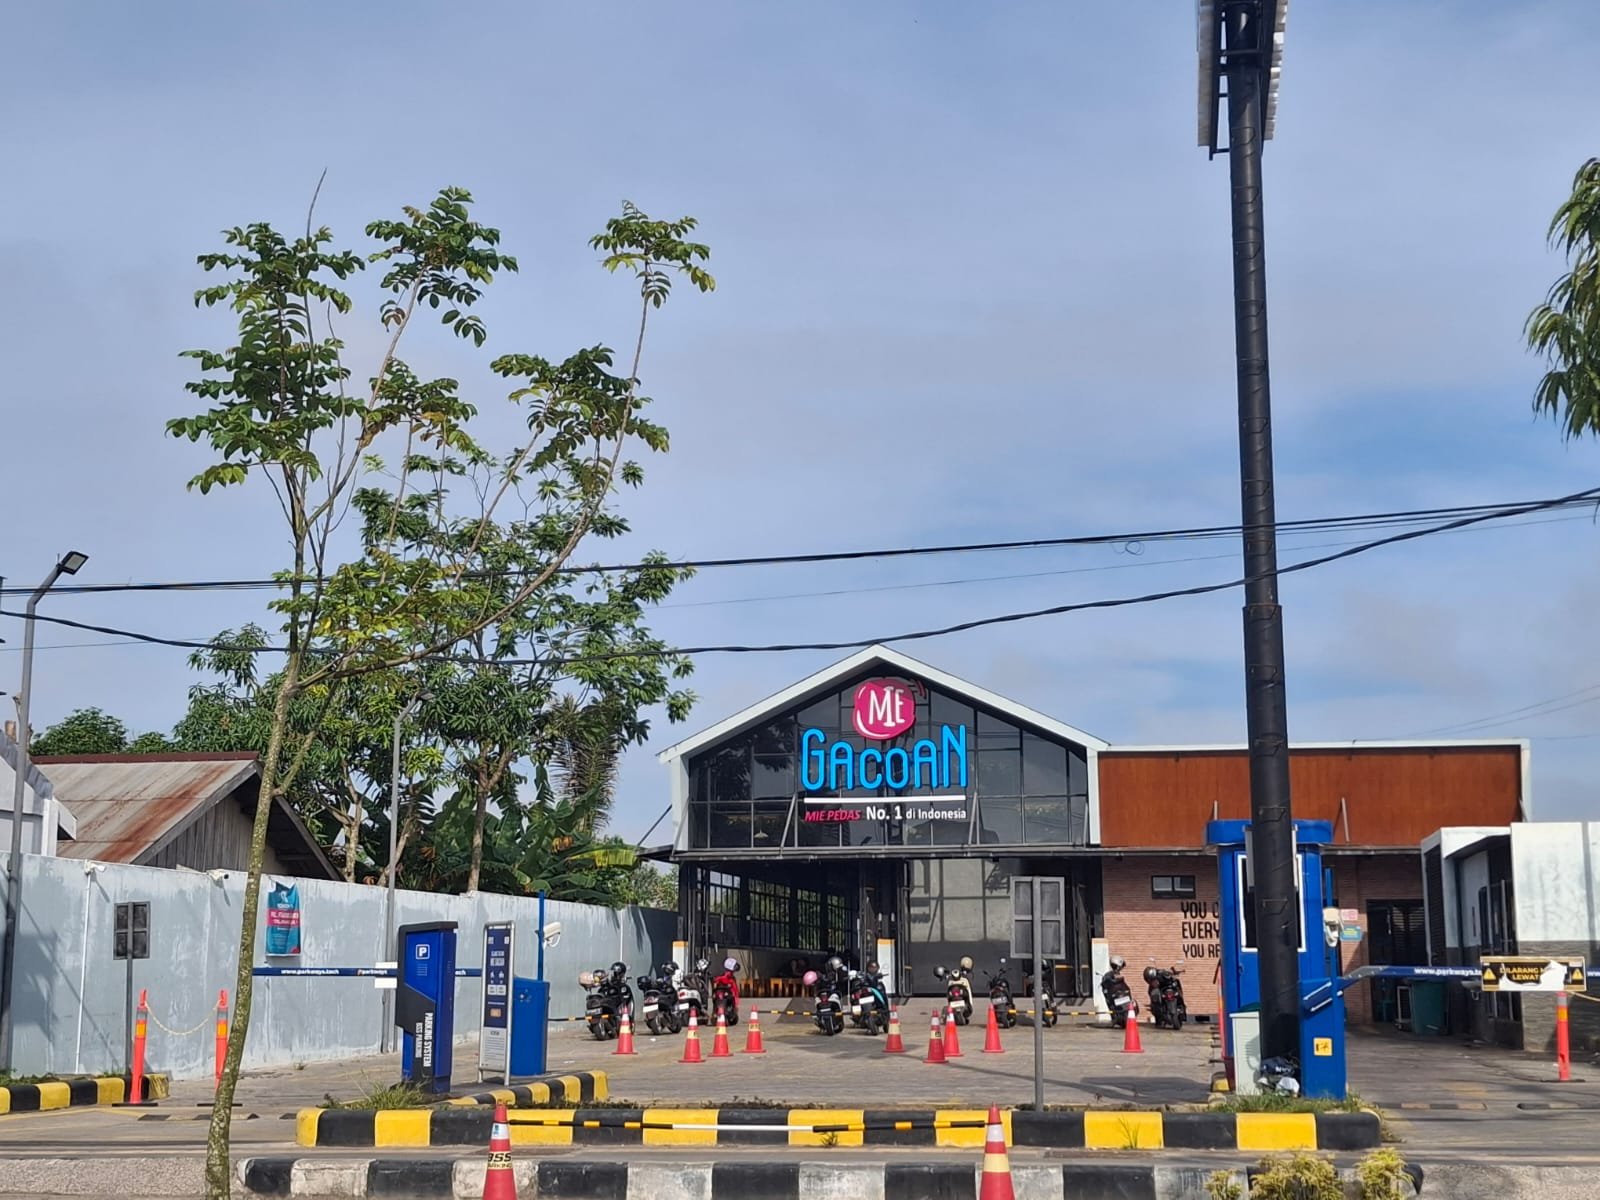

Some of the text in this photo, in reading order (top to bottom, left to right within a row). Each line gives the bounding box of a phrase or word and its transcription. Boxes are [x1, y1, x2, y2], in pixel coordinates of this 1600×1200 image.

[801, 723, 968, 791] GACOAN
[804, 805, 967, 822] MIE PEDAS No. 1 di Indonesia
[1180, 901, 1207, 919] YOU
[1182, 943, 1205, 959] YOU
